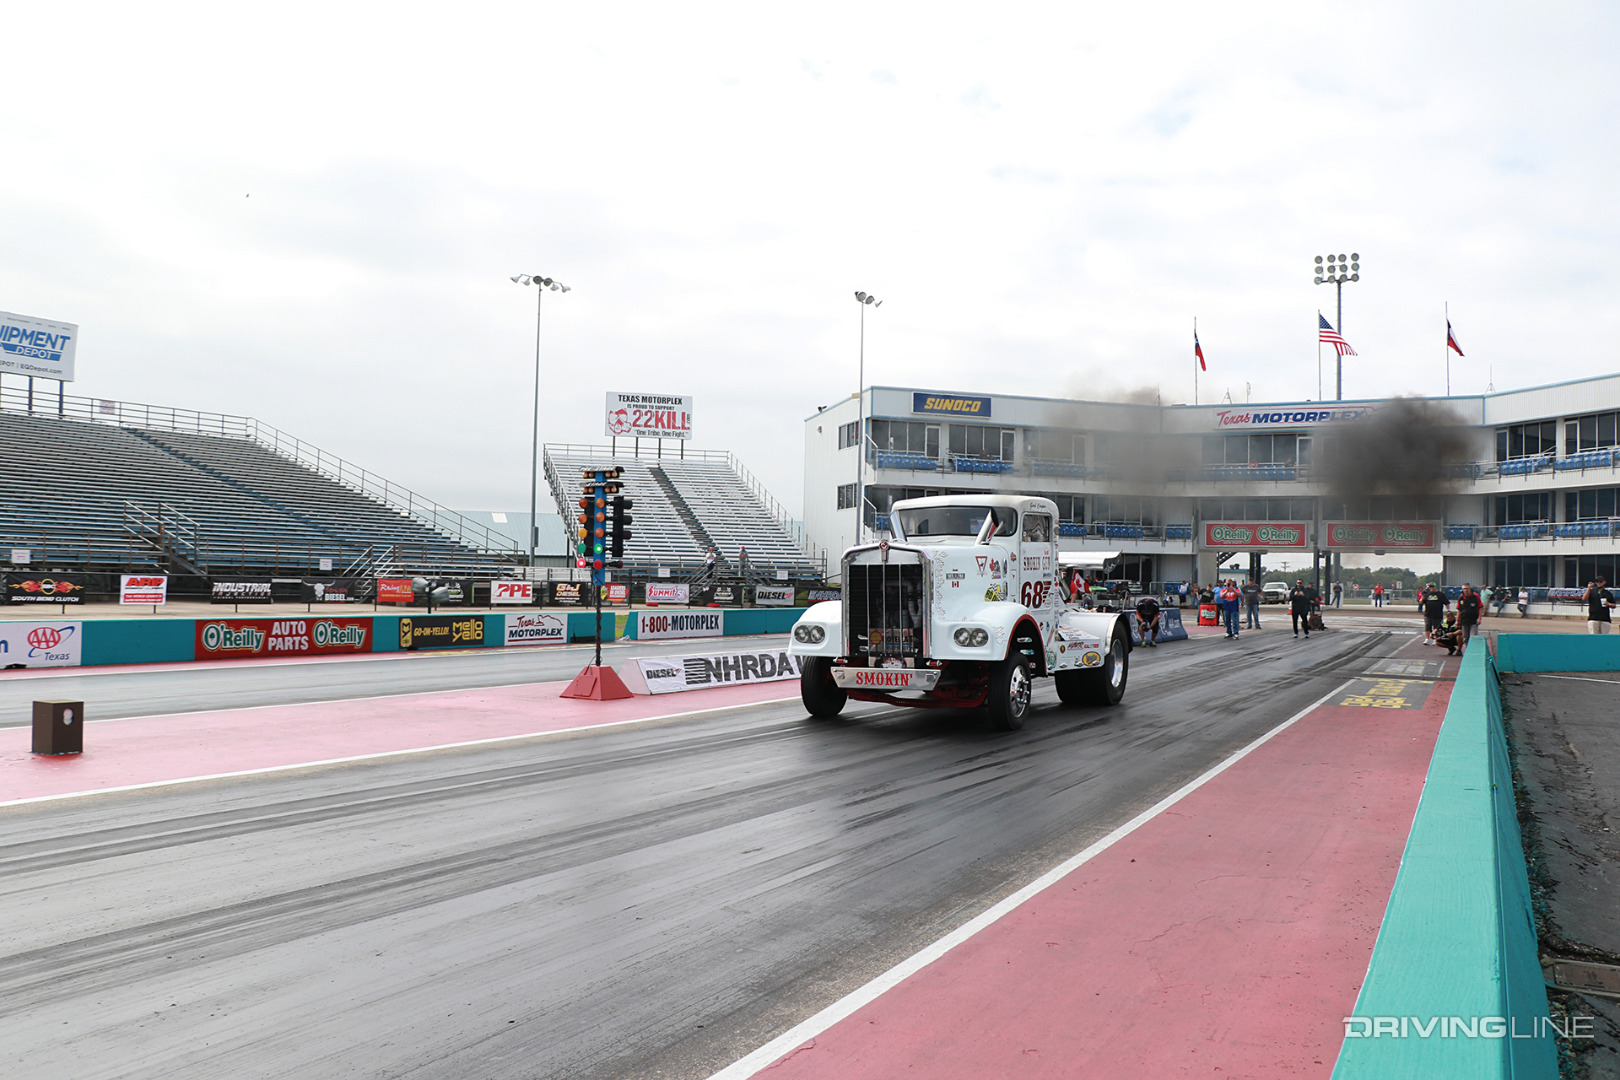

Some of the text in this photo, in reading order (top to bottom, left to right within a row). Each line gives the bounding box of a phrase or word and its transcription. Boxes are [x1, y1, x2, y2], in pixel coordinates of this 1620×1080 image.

[16, 346, 53, 359] DEPOT
[618, 395, 683, 405] TEXAS MOTORPLEX
[924, 397, 982, 412] SUNOCO
[632, 410, 690, 430] 22KILL
[1216, 410, 1366, 427] Texas MOTORPLEX
[1212, 525, 1299, 543] O'Reilly O'Reilly
[1334, 525, 1427, 543] O'Reilly O'Reilly
[125, 577, 165, 587] ARP
[496, 583, 532, 598] PPE
[757, 591, 785, 600] DIESEL
[1021, 581, 1044, 609] 68
[517, 615, 535, 628] Texas
[641, 615, 720, 633] 1-800-MOTORPLEX
[30, 628, 59, 649] AAA
[203, 620, 365, 651] O'Reilly AUTO O'Reilly
[508, 628, 563, 638] MOTORPLEX
[268, 636, 309, 651] PARTS
[44, 652, 70, 661] Texas
[646, 668, 677, 679] DIESEL
[700, 652, 795, 683] NHRDA
[855, 671, 913, 686] SMOKIN'
